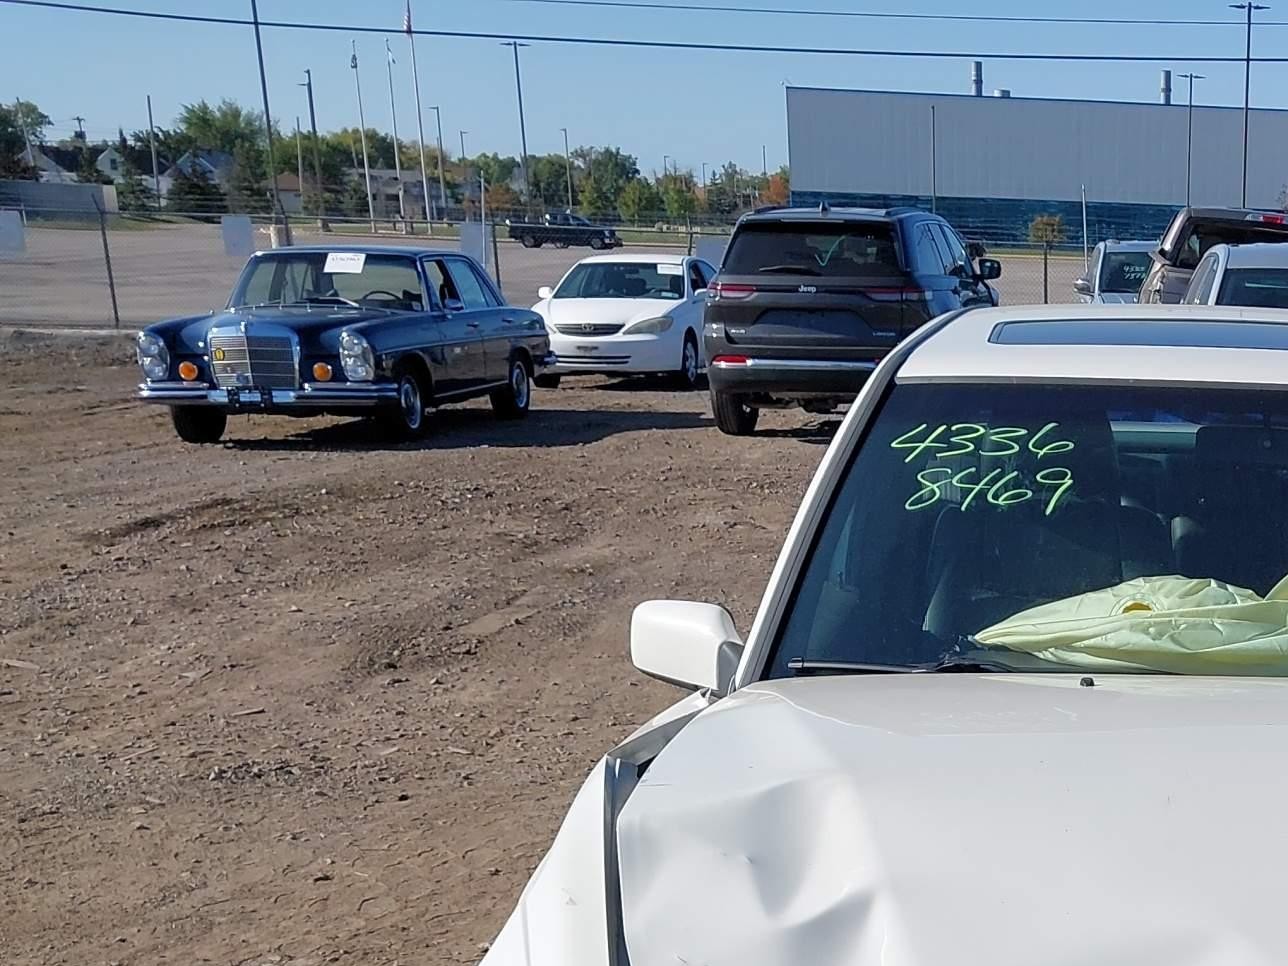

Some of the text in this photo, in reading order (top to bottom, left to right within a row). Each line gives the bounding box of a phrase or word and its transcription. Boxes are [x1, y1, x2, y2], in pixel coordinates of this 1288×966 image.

[798, 285, 816, 294] Jeep
[890, 422, 1076, 463] 4336
[904, 466, 1075, 516] 8469
